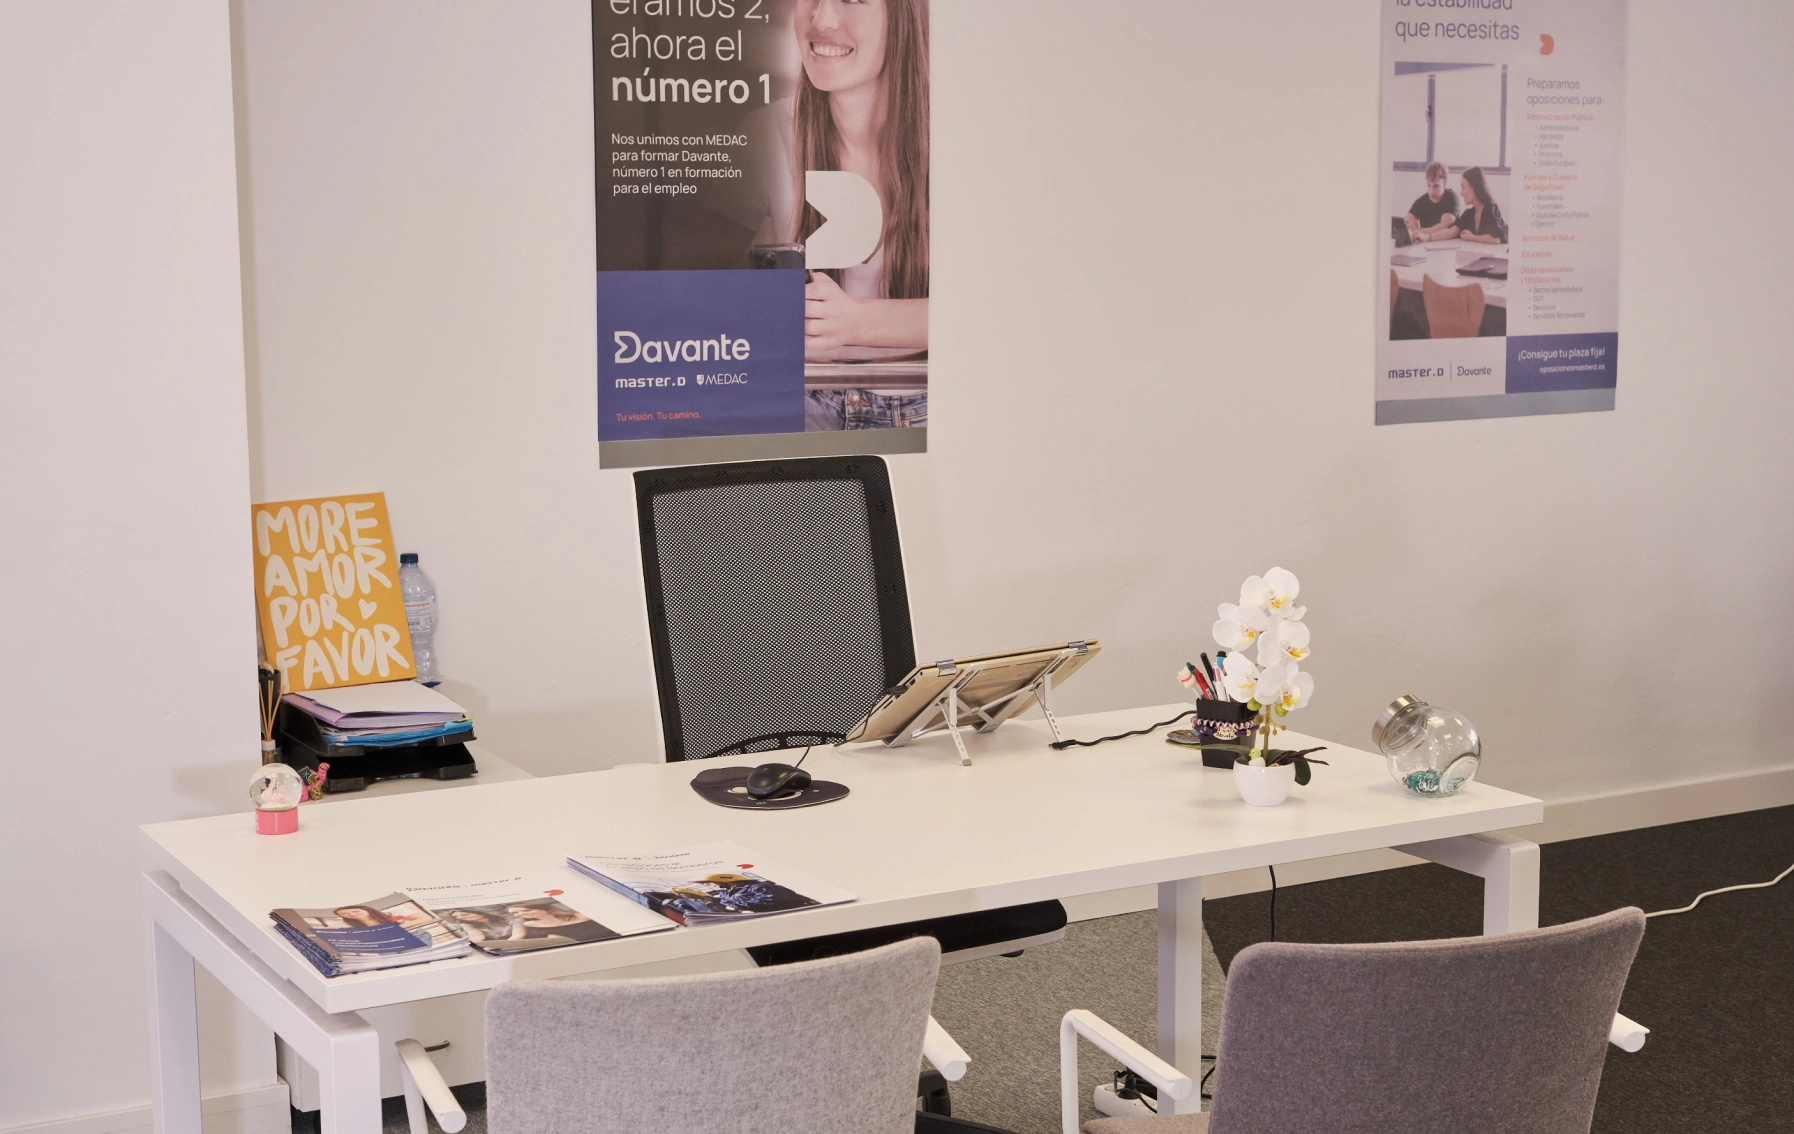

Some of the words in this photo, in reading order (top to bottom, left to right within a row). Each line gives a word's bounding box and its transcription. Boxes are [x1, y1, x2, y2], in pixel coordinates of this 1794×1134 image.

[744, 0, 770, 24] 2,
[1395, 21, 1430, 43] que
[1435, 20, 1520, 41] necesitas
[610, 27, 706, 61] ahora
[716, 30, 742, 61] el
[612, 67, 750, 104] número
[759, 73, 770, 104] 1
[1527, 78, 1580, 91] Preparamos
[1527, 94, 1581, 106] oposiciones
[611, 133, 635, 145] Nos
[637, 133, 680, 146] unimos
[682, 136, 704, 146] con
[706, 135, 748, 146] MEDAC
[612, 151, 639, 164] para
[640, 150, 680, 161] formar
[681, 151, 732, 164] Davante,
[612, 165, 658, 178] número
[660, 167, 665, 178] 1
[667, 168, 683, 178] en
[685, 166, 743, 178] formación
[613, 184, 640, 197] para
[641, 182, 652, 194] el
[654, 182, 698, 197] empleo
[614, 331, 751, 364] Davante
[1518, 349, 1558, 361] ¡Consigue
[1559, 348, 1568, 358] tu
[1568, 347, 1590, 359] plaza
[1590, 347, 1605, 359] fija!
[1457, 365, 1492, 377] Davante
[705, 373, 748, 386] MEDAC
[616, 413, 627, 422] Tu
[628, 411, 655, 421] visión.
[657, 411, 668, 420] Tu
[668, 411, 701, 420] camino.
[256, 501, 383, 557] MORE
[264, 546, 393, 600] AMOR
[270, 593, 355, 649] POR
[276, 623, 410, 694] FAVOR
